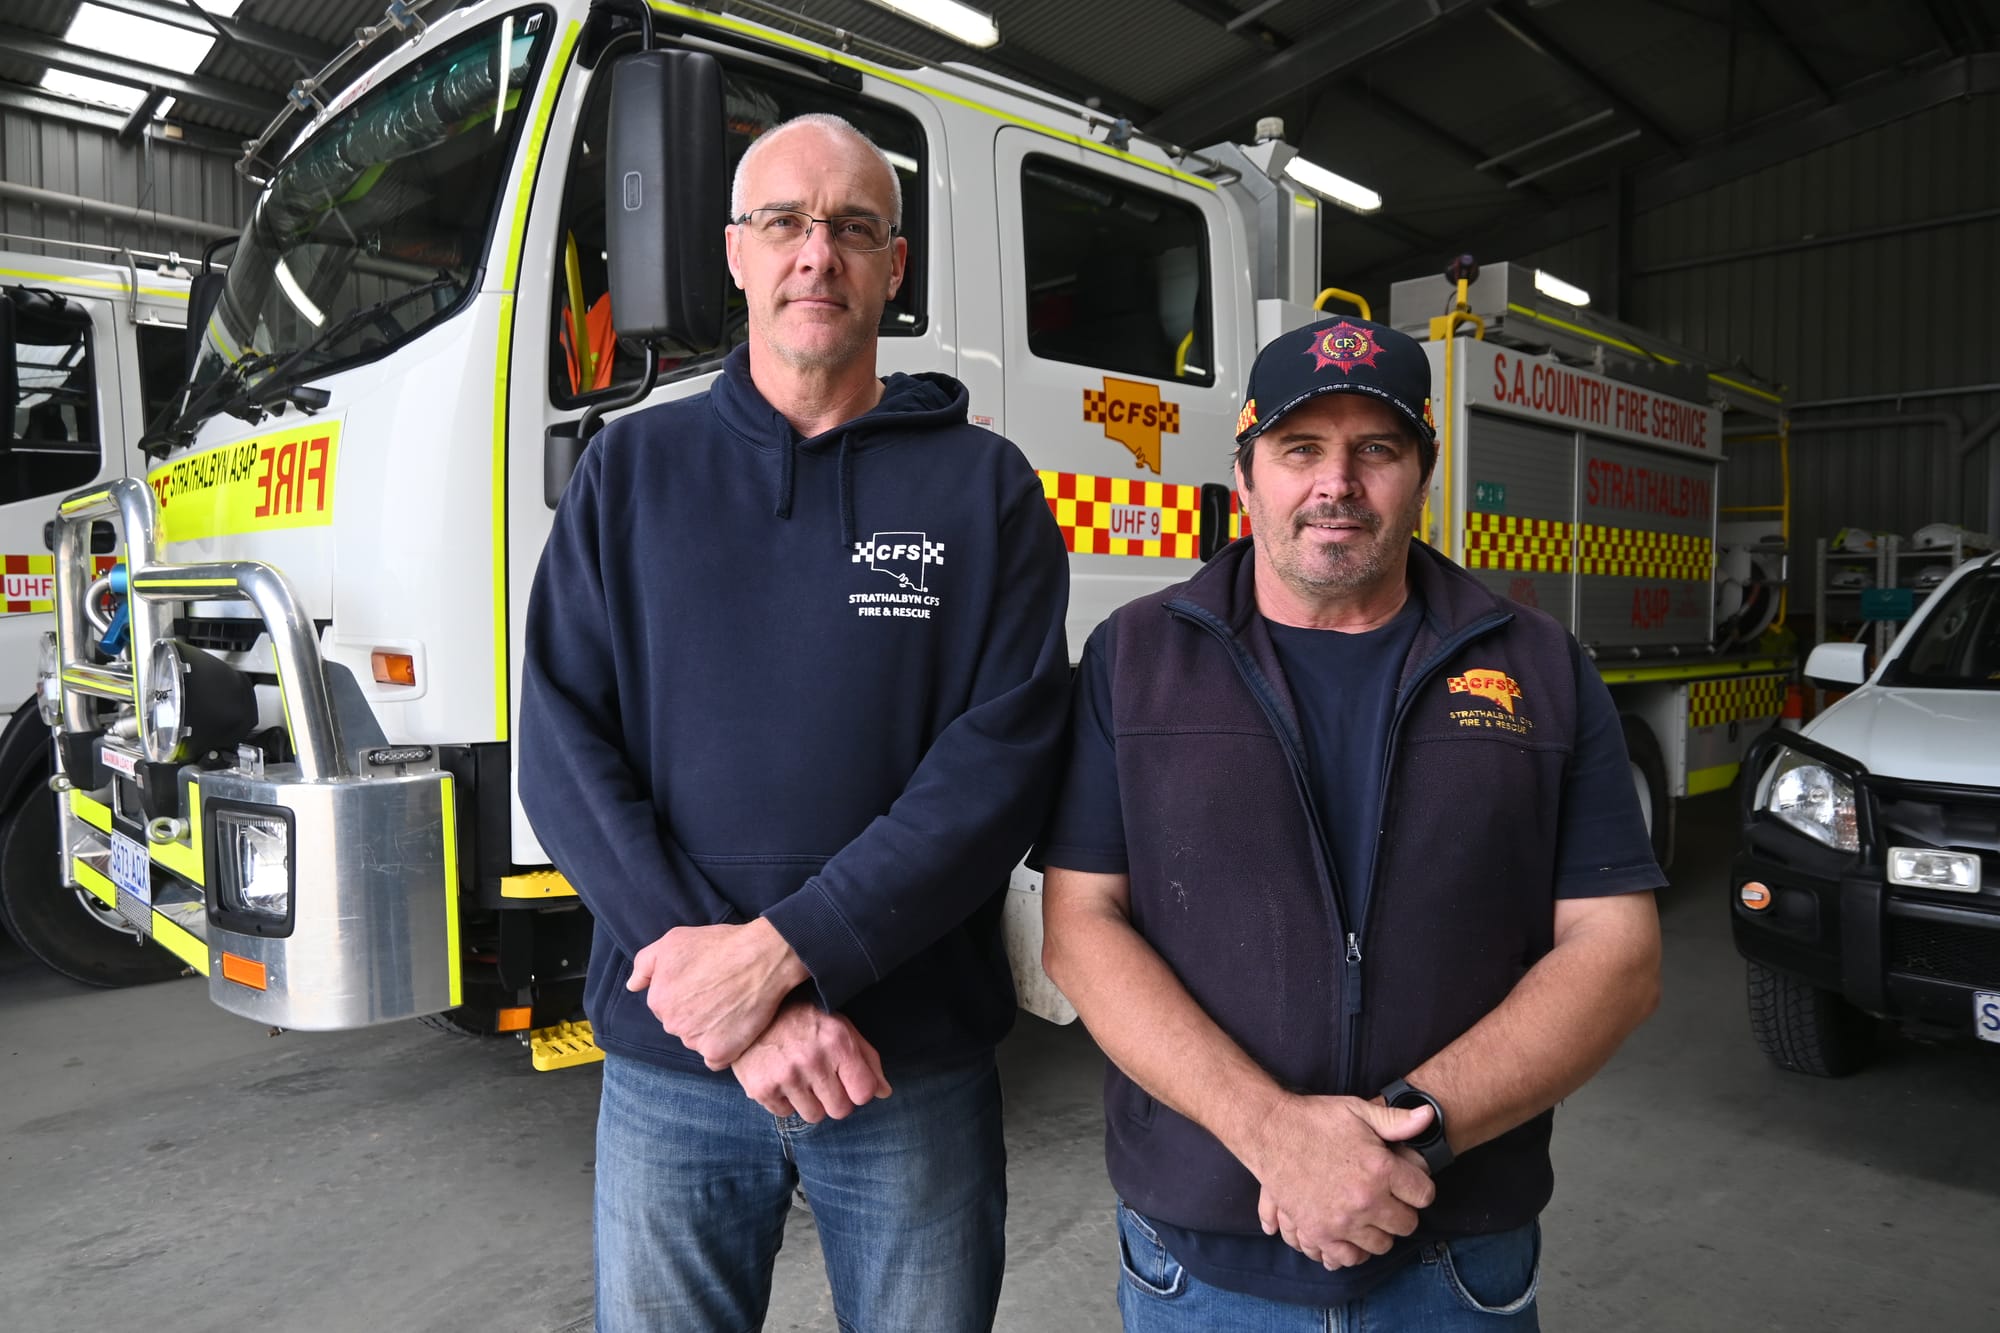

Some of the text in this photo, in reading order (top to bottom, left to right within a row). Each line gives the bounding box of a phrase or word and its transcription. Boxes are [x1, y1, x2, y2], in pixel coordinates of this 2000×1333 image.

[1335, 338, 1356, 349] CFS
[1108, 399, 1159, 428] CFS
[1616, 387, 1649, 435] FIRE
[1651, 398, 1708, 449] SERVICE
[170, 449, 230, 497] STRATHALBYN
[228, 443, 257, 482] A34P
[1586, 457, 1711, 521] STRATHALBYN
[1111, 508, 1160, 536] UHF 9
[876, 544, 921, 561] CFS
[7, 577, 54, 597] UHF
[848, 593, 941, 607] STRATHALBYN CFS
[858, 606, 931, 619] FIRE & RESCUE
[1469, 677, 1507, 691] CFS
[1459, 718, 1527, 735] FIRE & RESCUE
